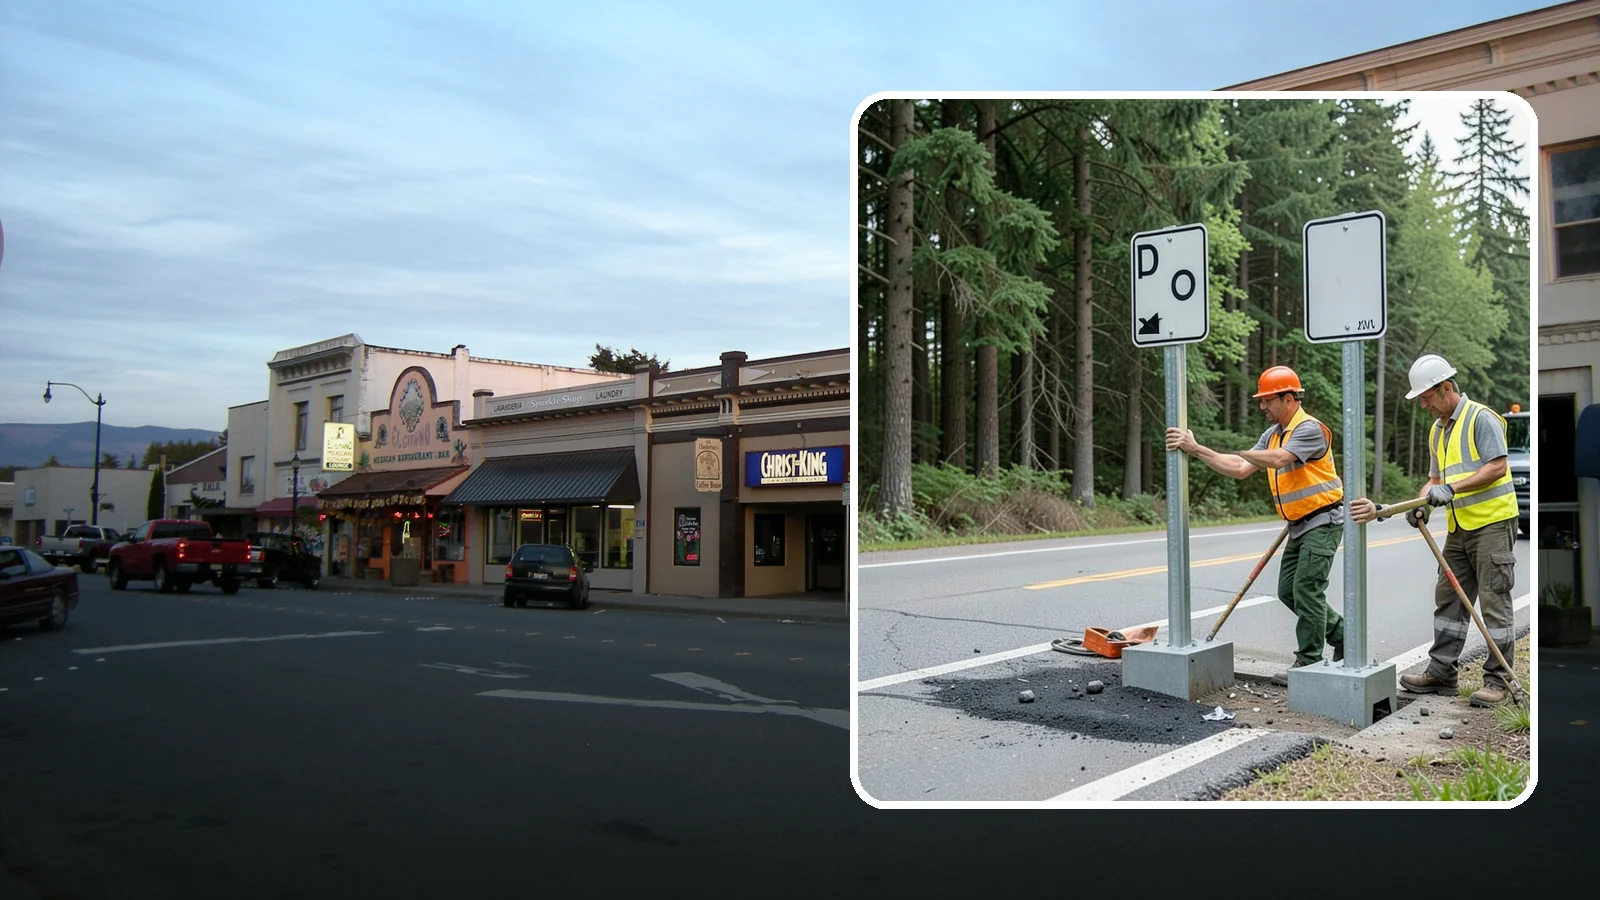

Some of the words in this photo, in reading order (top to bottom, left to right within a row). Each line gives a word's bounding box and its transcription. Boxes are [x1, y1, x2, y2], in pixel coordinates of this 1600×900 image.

[595, 389, 624, 400] LAUNDRY
[493, 402, 523, 413] LAVANDERIA
[530, 397, 561, 409] Sparkle
[562, 394, 583, 405] Shop
[373, 455, 396, 464] MEXICAN
[397, 451, 434, 462] RESTAURANT
[437, 450, 450, 459] BAR
[760, 452, 797, 478] CHRIST
[799, 450, 827, 476] KING
[696, 481, 709, 489] Coffee
[710, 481, 721, 489] House
